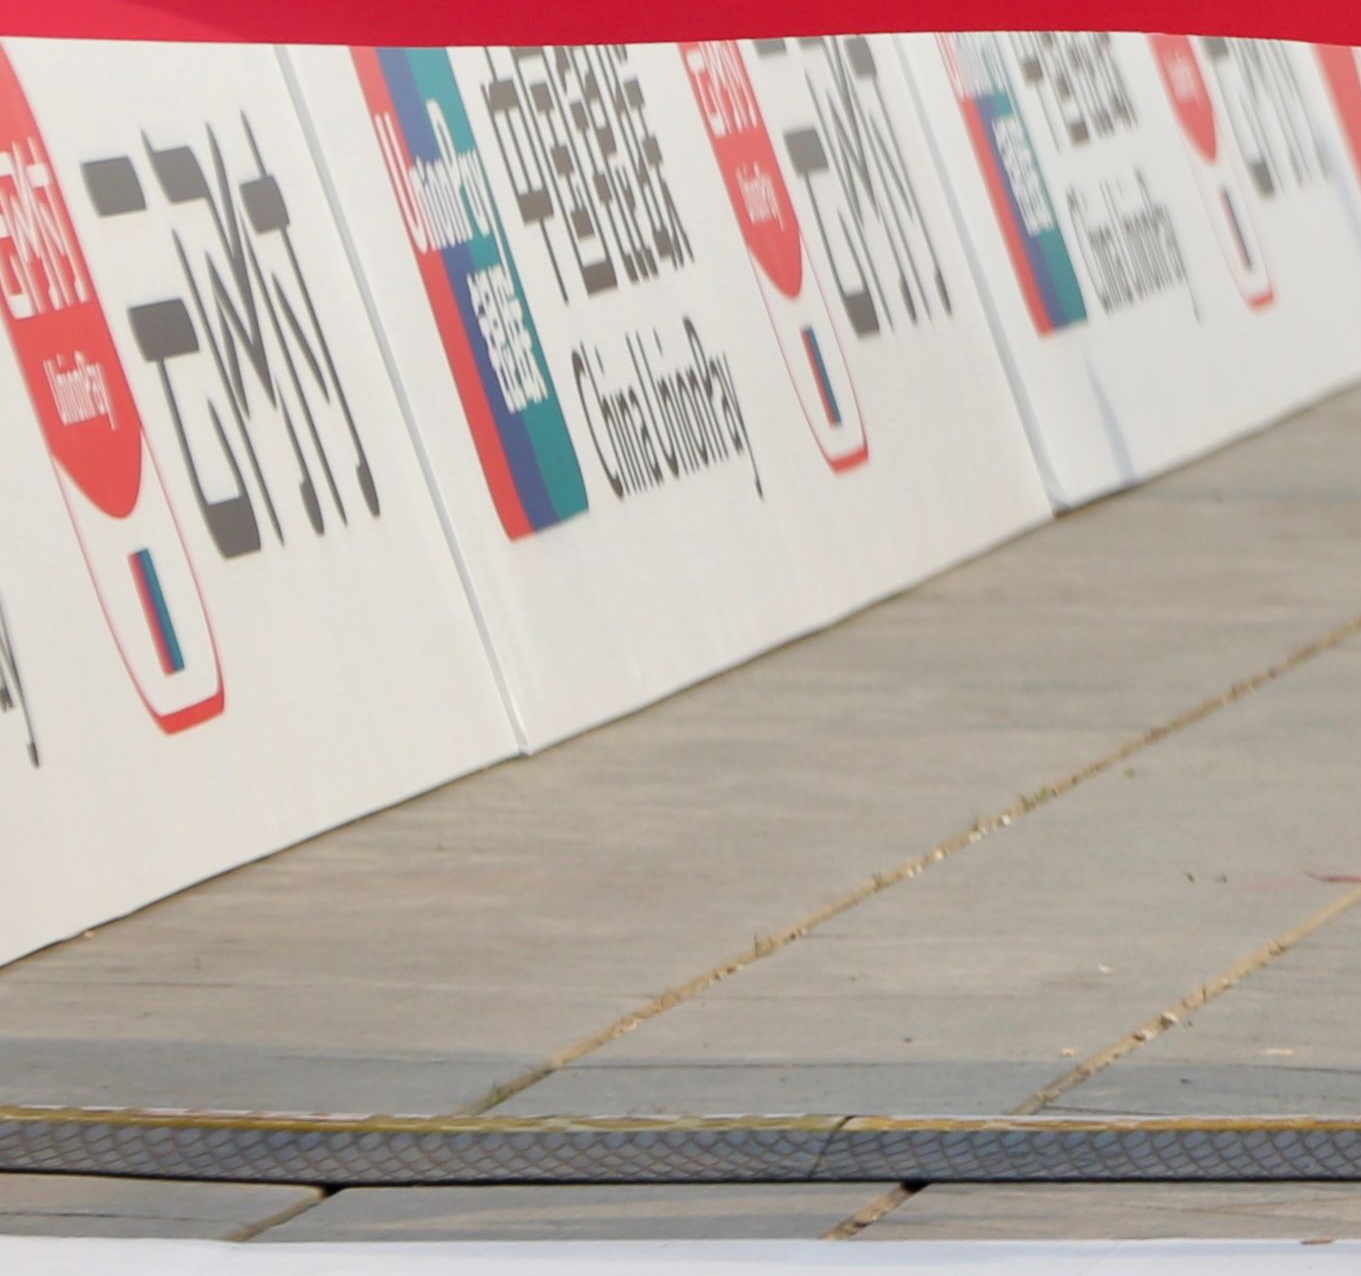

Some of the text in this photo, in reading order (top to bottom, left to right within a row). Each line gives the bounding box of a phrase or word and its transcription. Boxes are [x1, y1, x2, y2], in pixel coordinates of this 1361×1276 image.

[374, 96, 518, 286] UnionPay
[570, 314, 764, 502] China UnionPay
